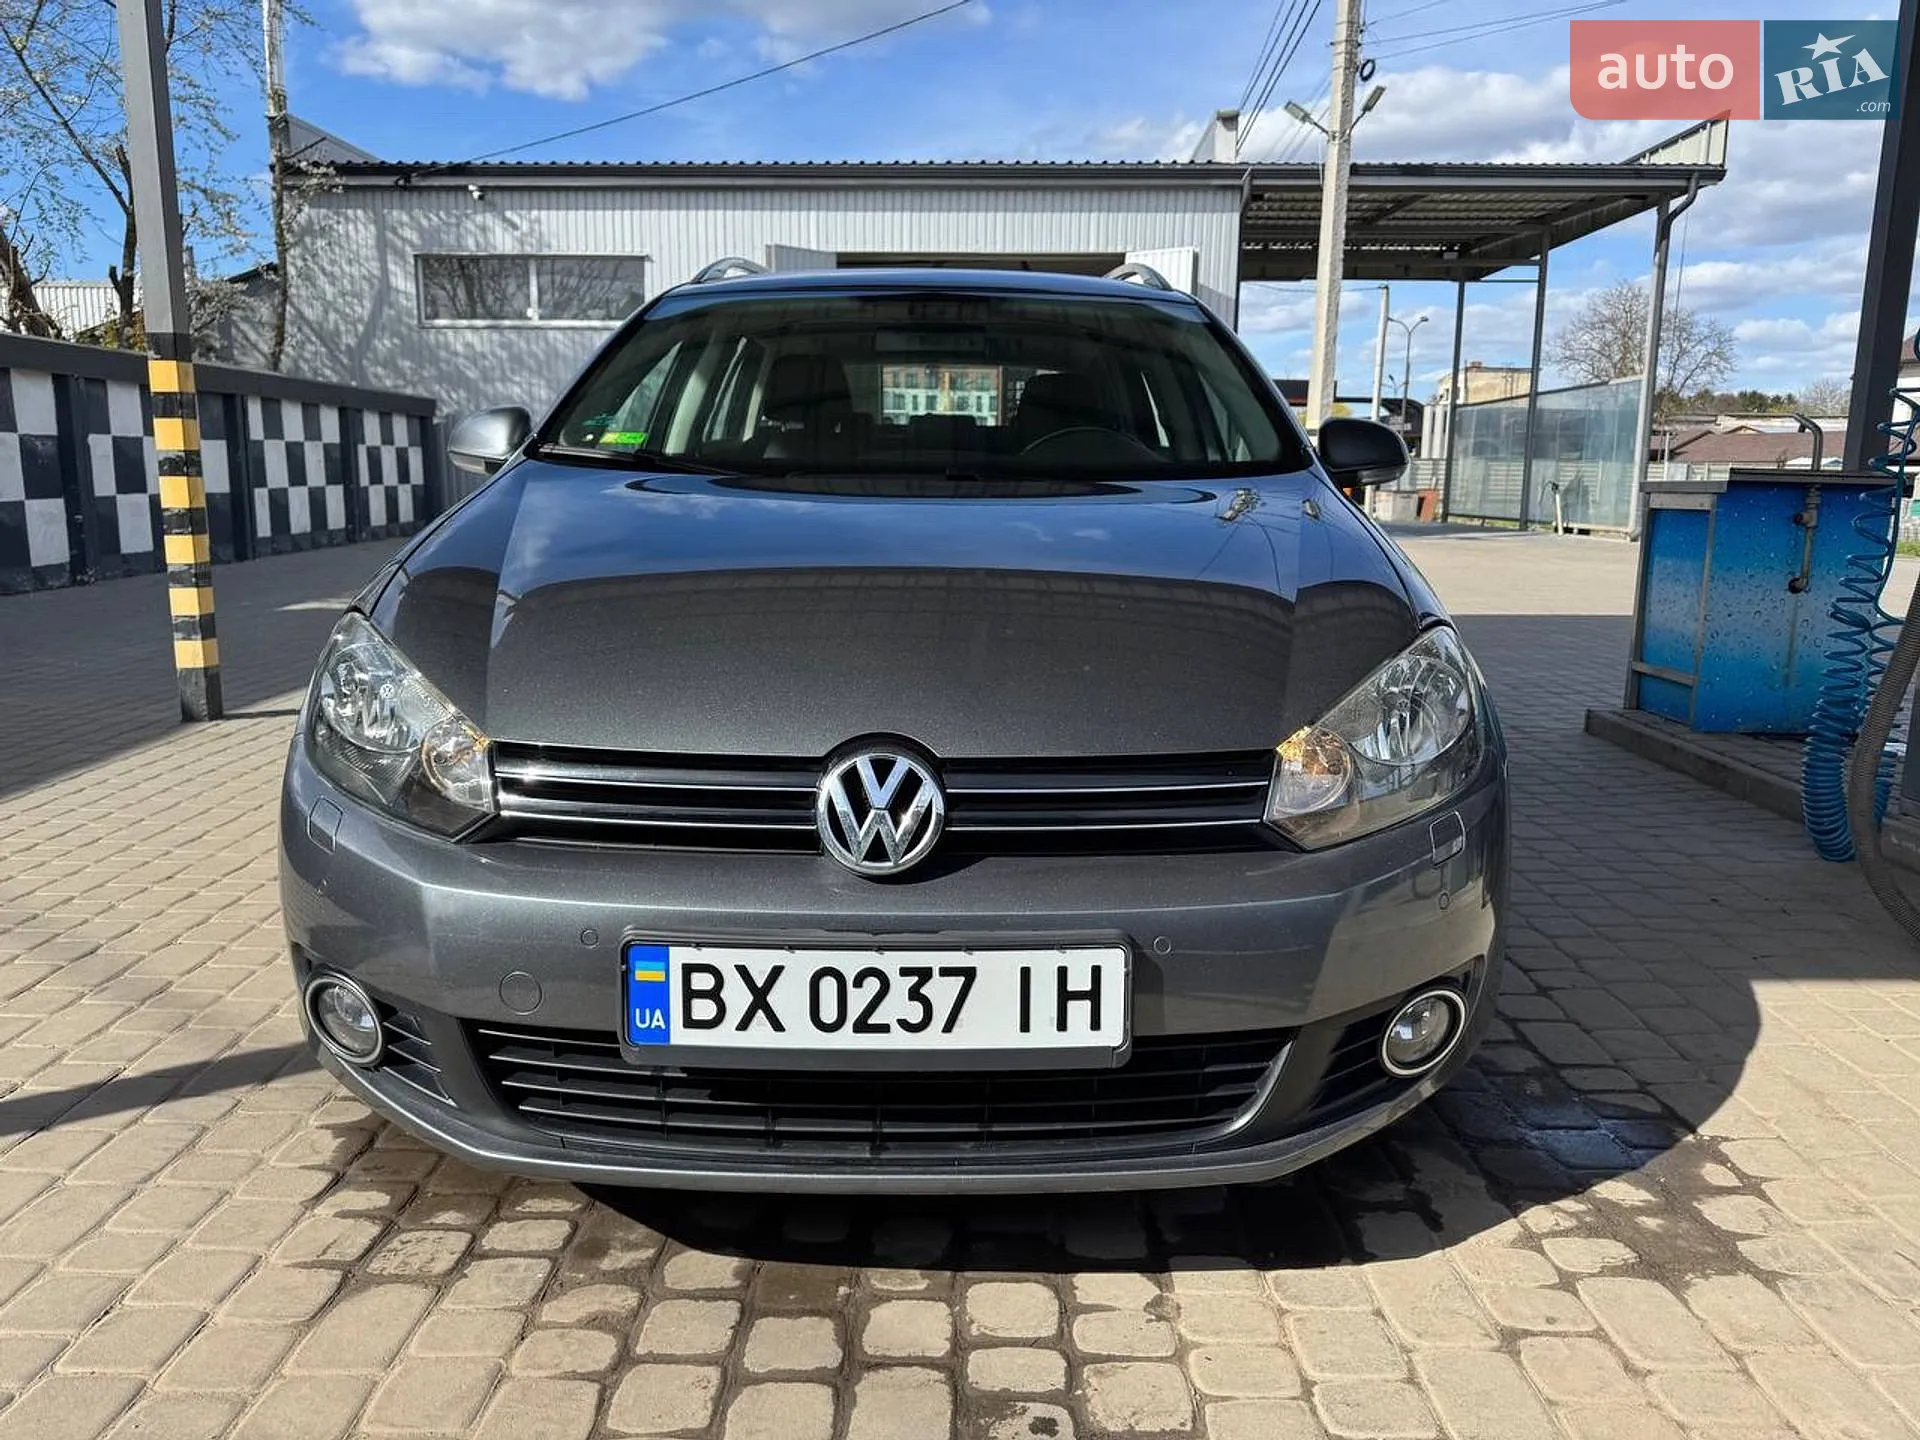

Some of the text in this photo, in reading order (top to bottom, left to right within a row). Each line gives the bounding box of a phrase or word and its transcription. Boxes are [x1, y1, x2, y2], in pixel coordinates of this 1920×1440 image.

[635, 1009, 665, 1029] UA
[682, 963, 785, 1033] BX
[809, 966, 977, 1034] 0237
